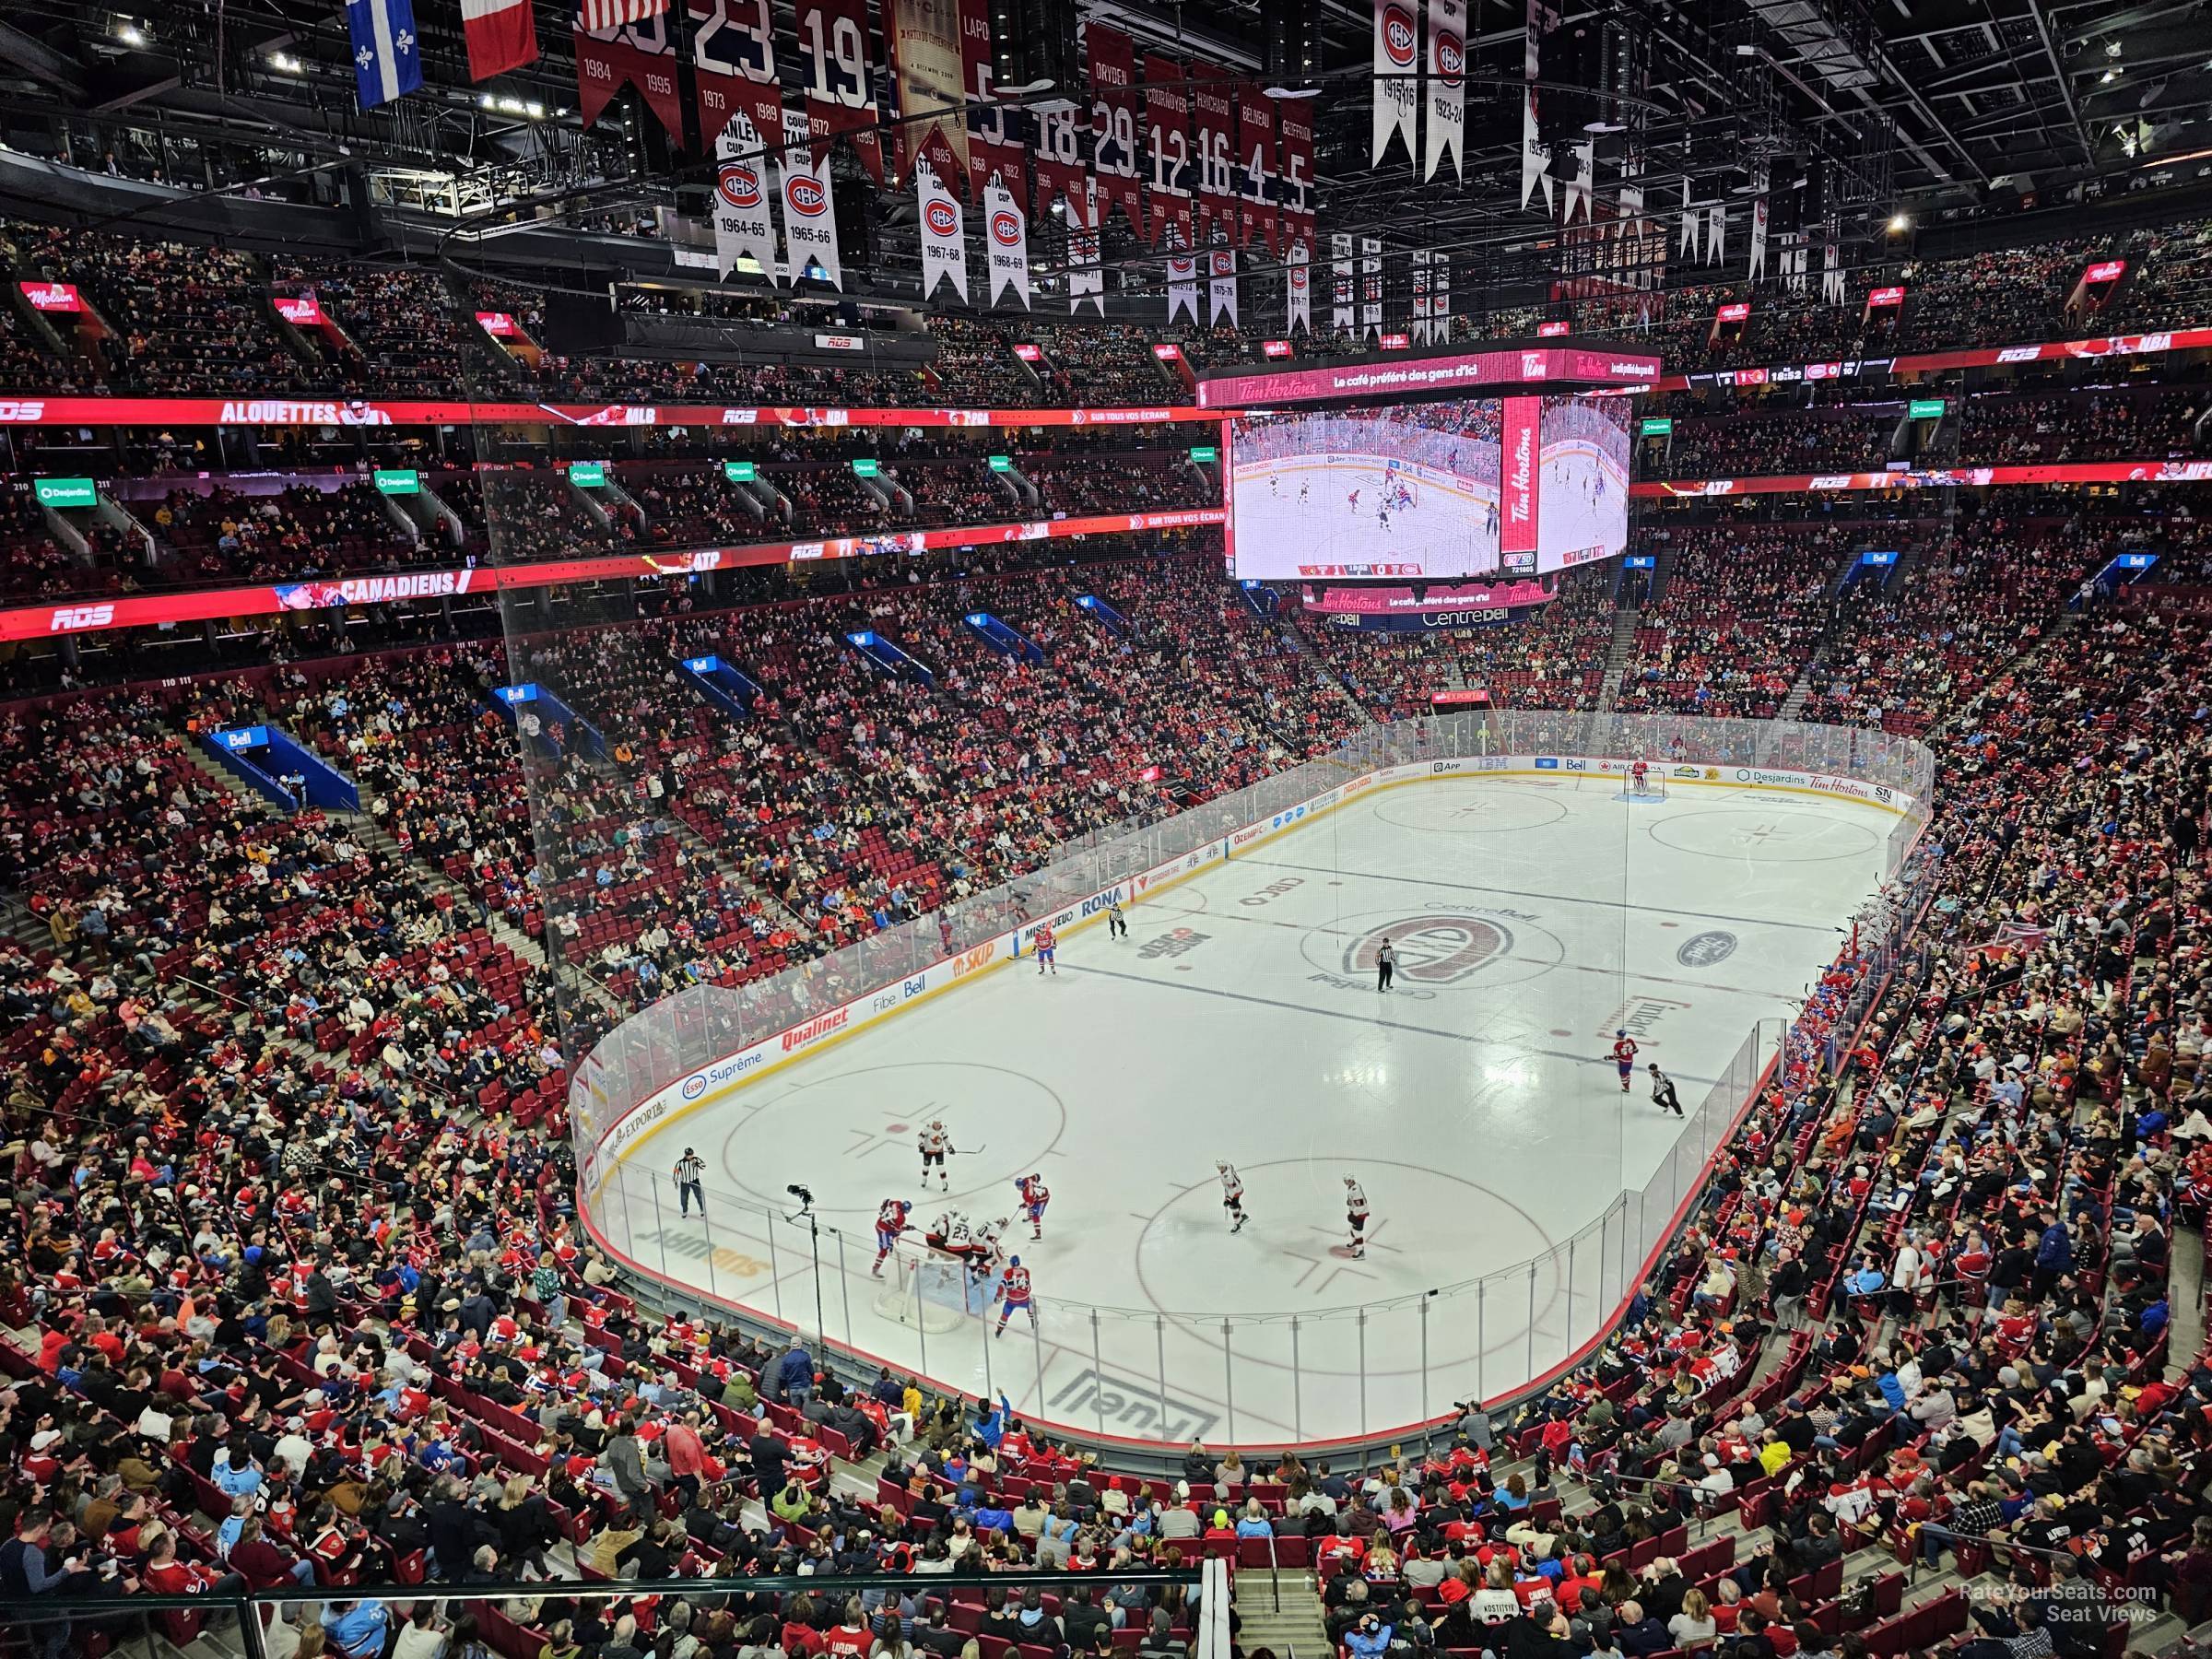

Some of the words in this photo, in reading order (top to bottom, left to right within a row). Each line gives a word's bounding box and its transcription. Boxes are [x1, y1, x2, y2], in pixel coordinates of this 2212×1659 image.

[1444, 4, 1456, 18] CUP
[964, 16, 989, 41] LAPO
[695, 0, 775, 85] 23
[804, 8, 867, 109] 19
[583, 58, 612, 81] 1984
[1096, 62, 1127, 86] DRYDEN
[646, 74, 672, 95] 1995
[703, 89, 725, 110] 1973
[1147, 88, 1187, 114] COURNOYER
[756, 102, 778, 122] 1989
[1435, 97, 1462, 126] 1923-24
[786, 115, 809, 129] COUP
[810, 117, 830, 136] 1972
[1092, 100, 1135, 178] 29
[726, 141, 745, 155] CUP
[932, 147, 951, 163] 1985
[794, 153, 811, 166] CUP
[971, 156, 986, 171] 1968
[1149, 124, 1189, 197] 12
[1199, 127, 1230, 196] 16
[1248, 143, 1265, 206] 4
[1069, 180, 1082, 194] 1981
[1290, 154, 1303, 214] 5
[998, 193, 1010, 203] CUP
[1124, 192, 1137, 206] 1979
[1152, 204, 1165, 218] 1963
[1178, 209, 1190, 222] 1979
[721, 217, 765, 237] 1964-65
[790, 226, 830, 244] 1965-66
[926, 245, 960, 262] 1967-68
[1333, 244, 1351, 257] STANLEY
[994, 254, 1023, 270] 1968-69
[28, 289, 74, 306] Molson
[280, 306, 316, 319] Molson
[2138, 335, 2171, 352] NBA
[1522, 353, 1547, 378] Tim
[1335, 377, 1346, 388] Le
[1347, 374, 1369, 387] café
[1371, 371, 1406, 387] préféré
[1408, 370, 1427, 382] des
[1429, 367, 1454, 382] gens
[1455, 364, 1477, 376] d'ici
[1771, 371, 1801, 382] 18:52
[1239, 382, 1264, 401] Tim
[1265, 379, 1317, 399] Hortons
[0, 402, 44, 421] DS
[220, 402, 336, 423] ALOUETTES
[626, 407, 655, 424] MLB
[826, 410, 848, 425] NBA
[1091, 412, 1105, 421] SUR
[1106, 411, 1124, 421] TOUS
[1125, 411, 1139, 420] VOS
[1141, 409, 1171, 420] ÉCRANS
[1918, 405, 1942, 414] Desjardins
[1512, 427, 1532, 490] Hortons
[386, 477, 415, 487] Desjardins
[418, 471, 429, 479] 212
[579, 471, 602, 482] Desjardins
[1870, 474, 1888, 488] F1
[13, 483, 29, 491] 210
[97, 480, 111, 488] 211
[1705, 481, 1733, 495] ATP
[53, 488, 91, 498] Desjardins
[1511, 492, 1530, 524] Tim
[1148, 517, 1163, 526] SUR
[1164, 514, 1182, 524] TOUS
[1182, 513, 1198, 524] VOS
[1200, 510, 1225, 523] ÉCRAN
[840, 540, 852, 556] F1
[694, 551, 720, 571] ATP
[1633, 558, 1645, 566] Bell
[1873, 554, 1887, 563] Bell
[2130, 556, 2146, 566] Bell
[341, 573, 454, 600] CANADIENS
[1323, 593, 1338, 608] Tim
[1338, 593, 1382, 609] Hortons
[51, 605, 114, 631] RDS
[854, 634, 865, 645] Bell
[693, 659, 706, 672] Bell
[162, 679, 175, 689] 110
[179, 677, 192, 686] 111
[506, 688, 524, 702] Bell
[229, 732, 251, 747] Bell
[1477, 758, 1509, 770] IBM
[1567, 759, 1585, 771] Bell
[1754, 771, 1805, 784] Desjardins
[1809, 776, 1829, 790] Tim
[1830, 779, 1868, 798] Hortons
[1875, 786, 1892, 799] SN
[1253, 877, 1305, 899] CIBC
[1081, 888, 1122, 918] RONA
[966, 943, 995, 972] SKIP
[873, 994, 896, 1014] Fibe
[904, 975, 925, 998] Bell
[782, 1006, 849, 1052] Qualinet
[710, 1052, 763, 1085] Suprême
[953, 1226, 969, 1241] 23
[634, 1229, 772, 1278] SUBWAY
[1013, 1276, 1027, 1289] 14
[1484, 1603, 1515, 1613] KOSTITSYN
